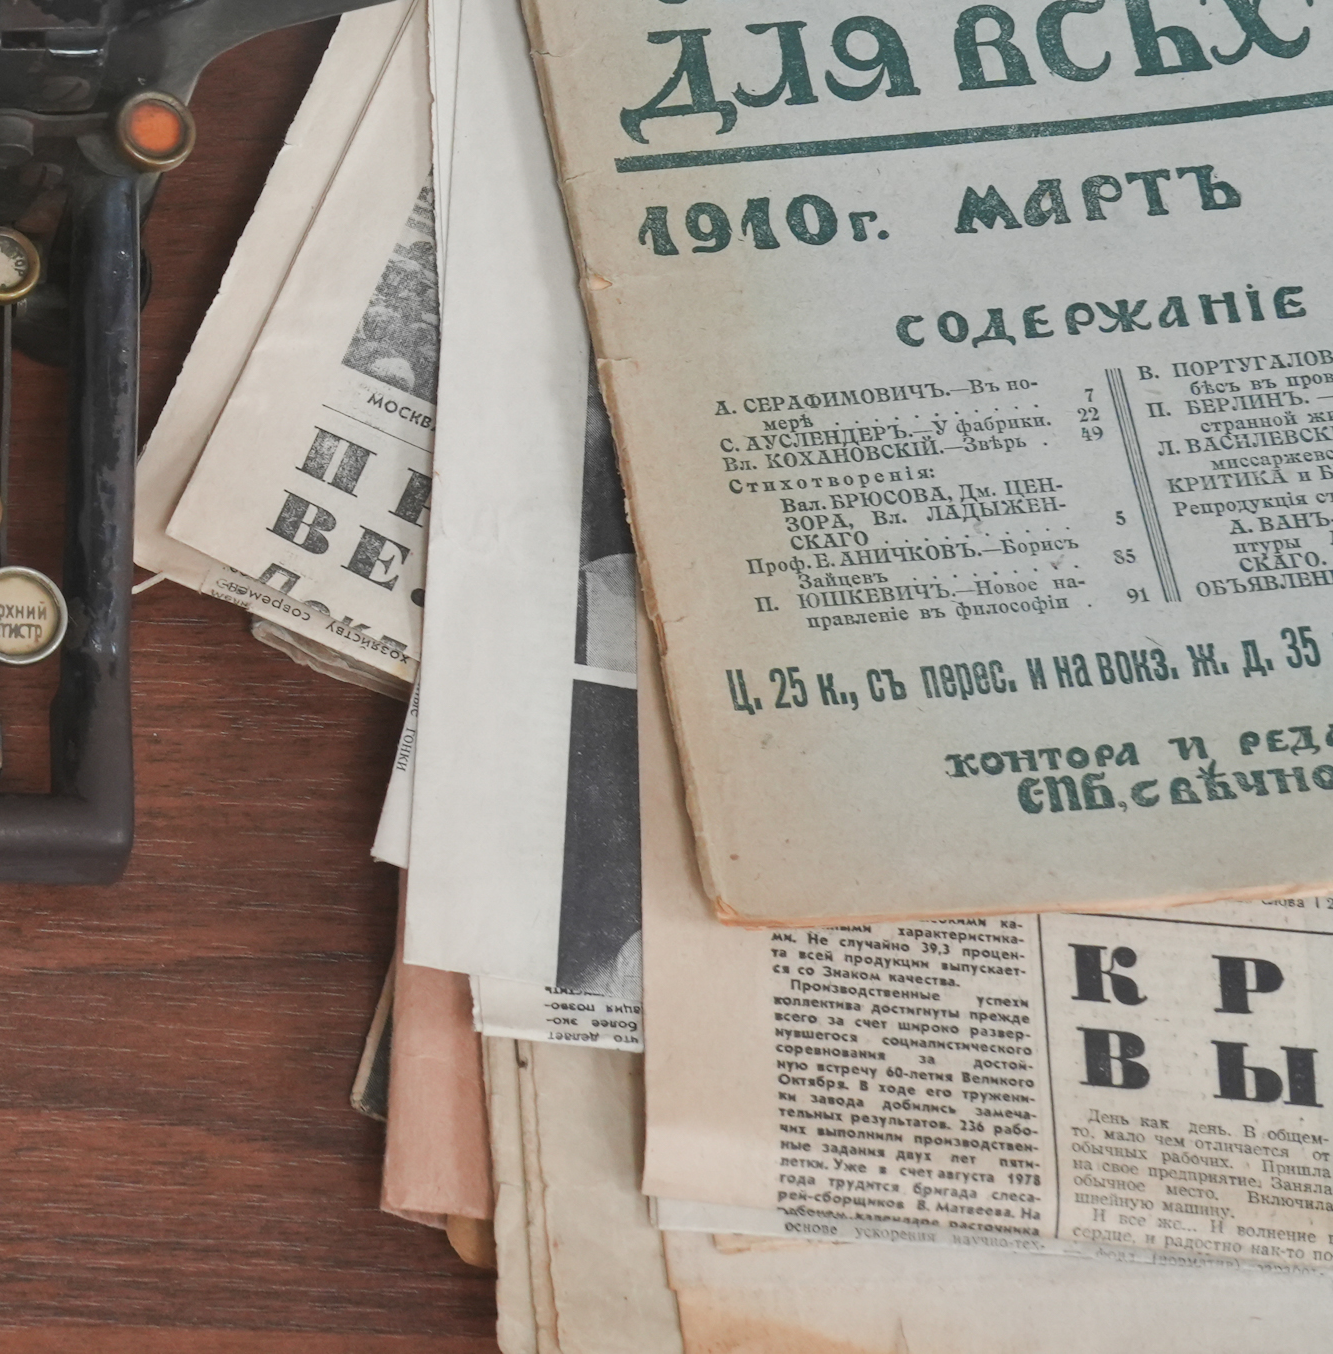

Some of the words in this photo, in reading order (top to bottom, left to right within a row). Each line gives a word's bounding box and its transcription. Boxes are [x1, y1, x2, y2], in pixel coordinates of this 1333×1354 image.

[620, 15, 921, 144] ДЛЯ
[367, 392, 436, 433] МОСКВ
[1076, 406, 1101, 423] 22
[1200, 409, 1299, 436] странной
[955, 414, 1052, 437] фабрики.
[1080, 425, 1104, 442] 49
[1166, 468, 1289, 494] КРИТИКА
[779, 497, 827, 514] Вал.
[829, 485, 953, 511] БРЮСОВА,
[1004, 477, 1063, 498] ЦЕН-
[784, 512, 855, 533] ЗОРА,
[926, 495, 1067, 523] ЛАДЫЖЕН-
[789, 530, 870, 551] СКАГО
[745, 555, 812, 577] Проф.
[1238, 550, 1328, 574] СКАГО.
[797, 570, 889, 590] Зайцевъ
[1126, 587, 1151, 604] 91
[725, 668, 763, 716] Ц.
[769, 666, 809, 711] 25
[866, 664, 908, 704] съ
[920, 658, 1018, 703] перес.
[1032, 657, 1048, 691] и
[1053, 651, 1093, 690] на
[1098, 645, 1179, 685] вокз.
[1280, 625, 1322, 670] 35
[1087, 1108, 1130, 1126] День
[1139, 1116, 1170, 1130] как
[1188, 1120, 1232, 1138] день.
[1194, 1137, 1290, 1159] отличается
[1161, 1149, 1234, 1169] рабочих.
[1261, 1158, 1332, 1180] Пришла
